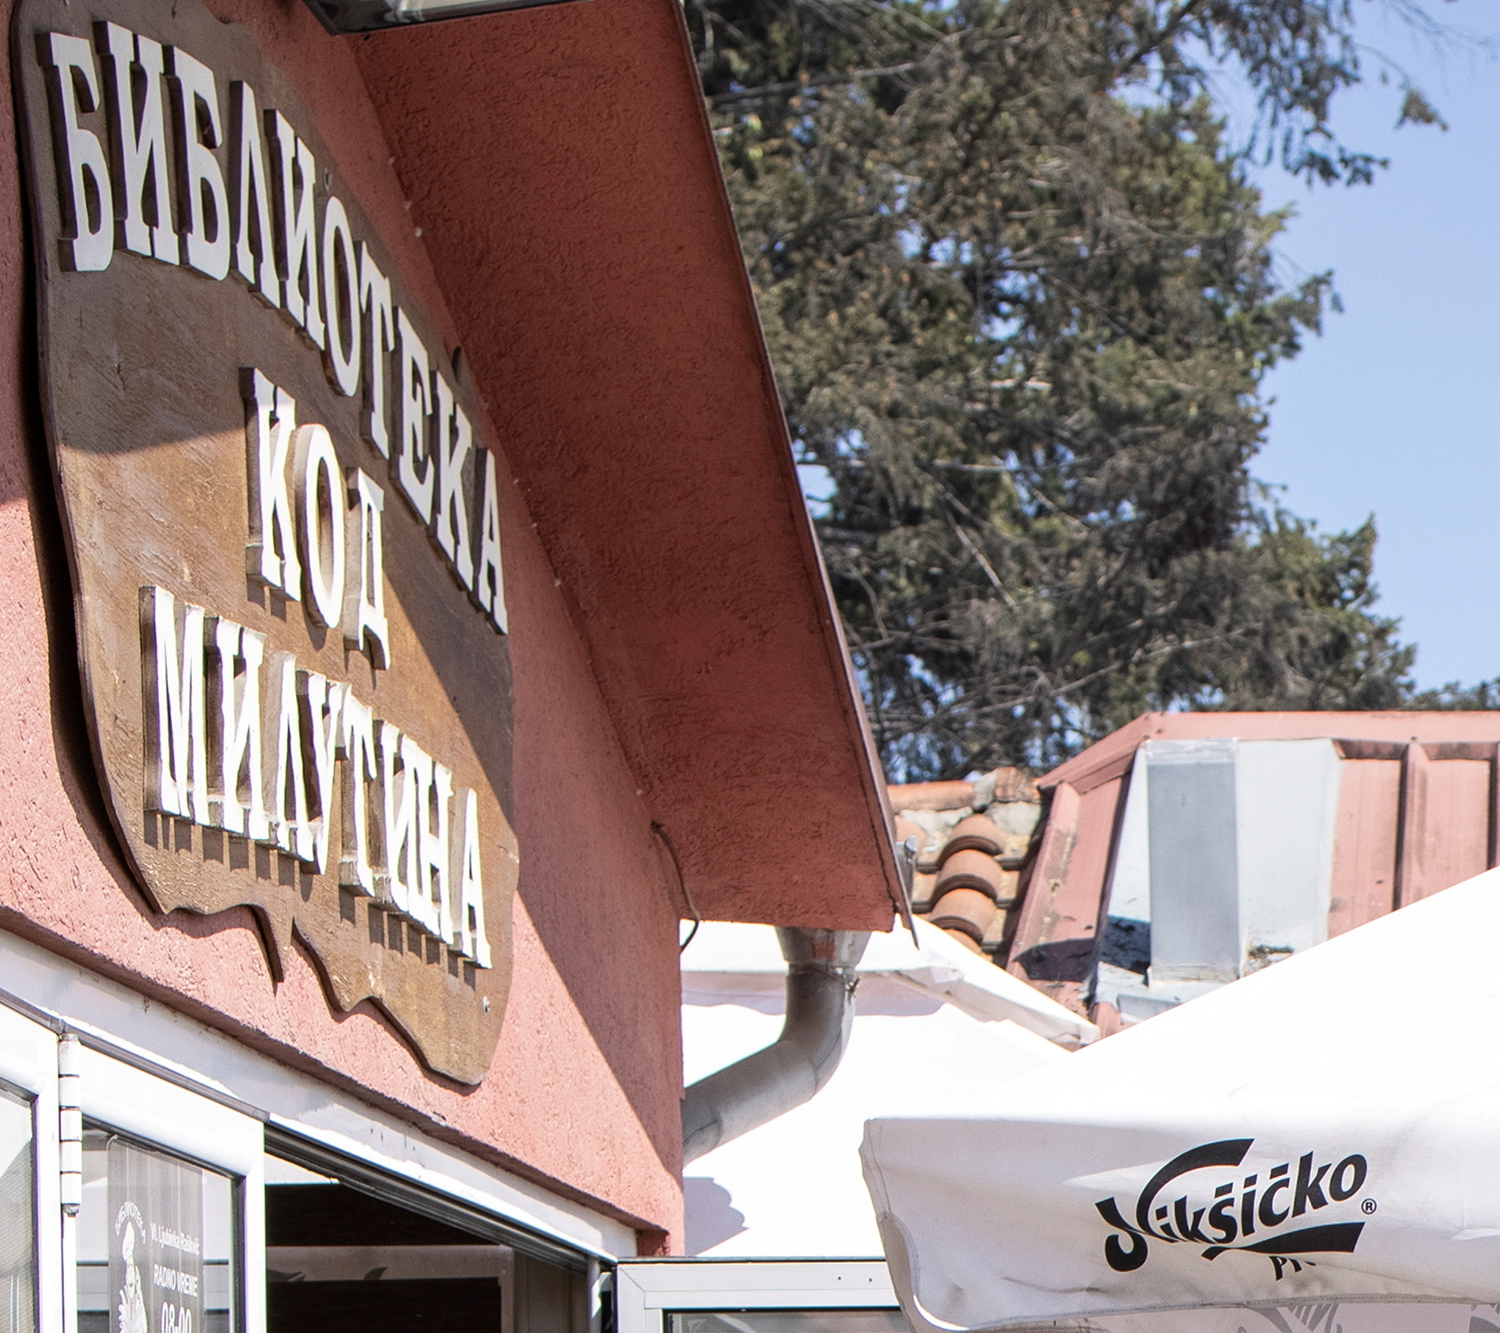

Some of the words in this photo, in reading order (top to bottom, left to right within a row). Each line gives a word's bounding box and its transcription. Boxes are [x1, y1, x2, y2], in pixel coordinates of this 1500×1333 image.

[45, 22, 509, 635] БИБЛИОТЕКА
[251, 368, 390, 671] КОД
[152, 586, 492, 970] МИЛУТИНА
[153, 1264, 176, 1291] RADNO
[177, 1271, 198, 1298] VREME
